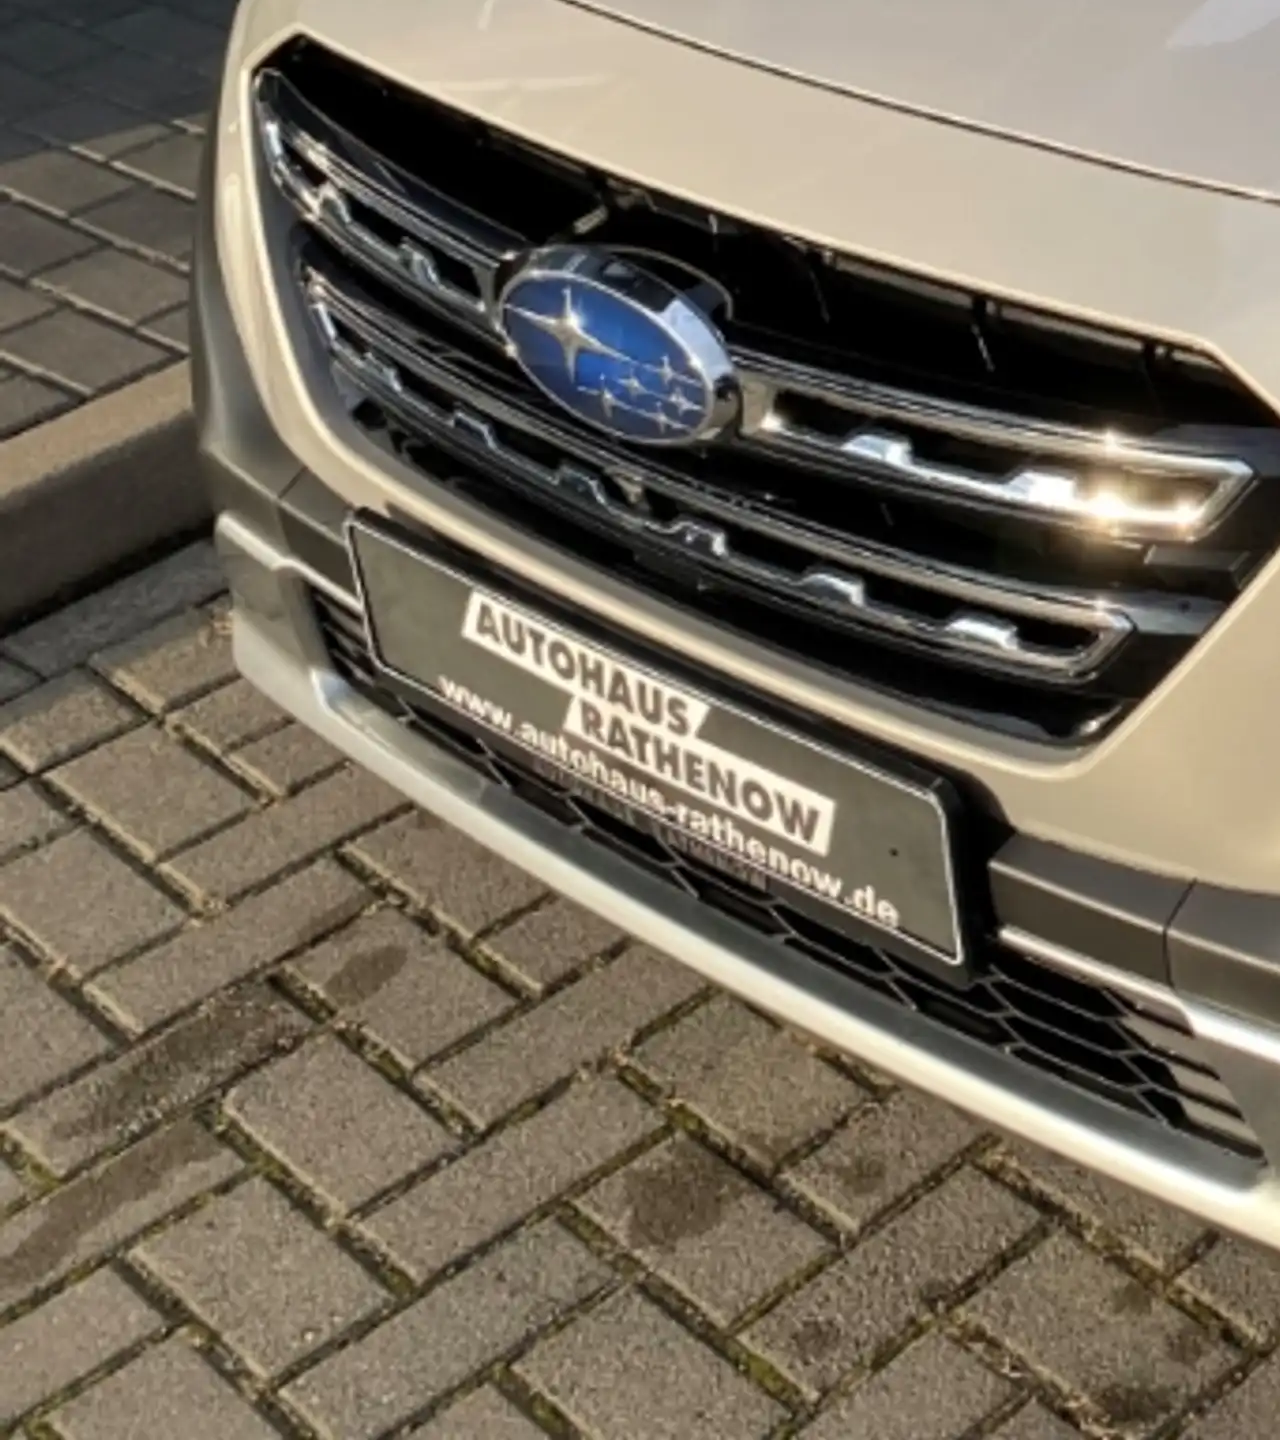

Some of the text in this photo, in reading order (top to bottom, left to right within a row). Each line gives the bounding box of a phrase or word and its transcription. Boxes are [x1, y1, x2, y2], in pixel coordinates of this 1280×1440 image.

[474, 598, 692, 738] AUTOHAUS
[436, 675, 900, 929] www.autohaus-rathenow.de
[578, 698, 821, 847] RATHENOW
